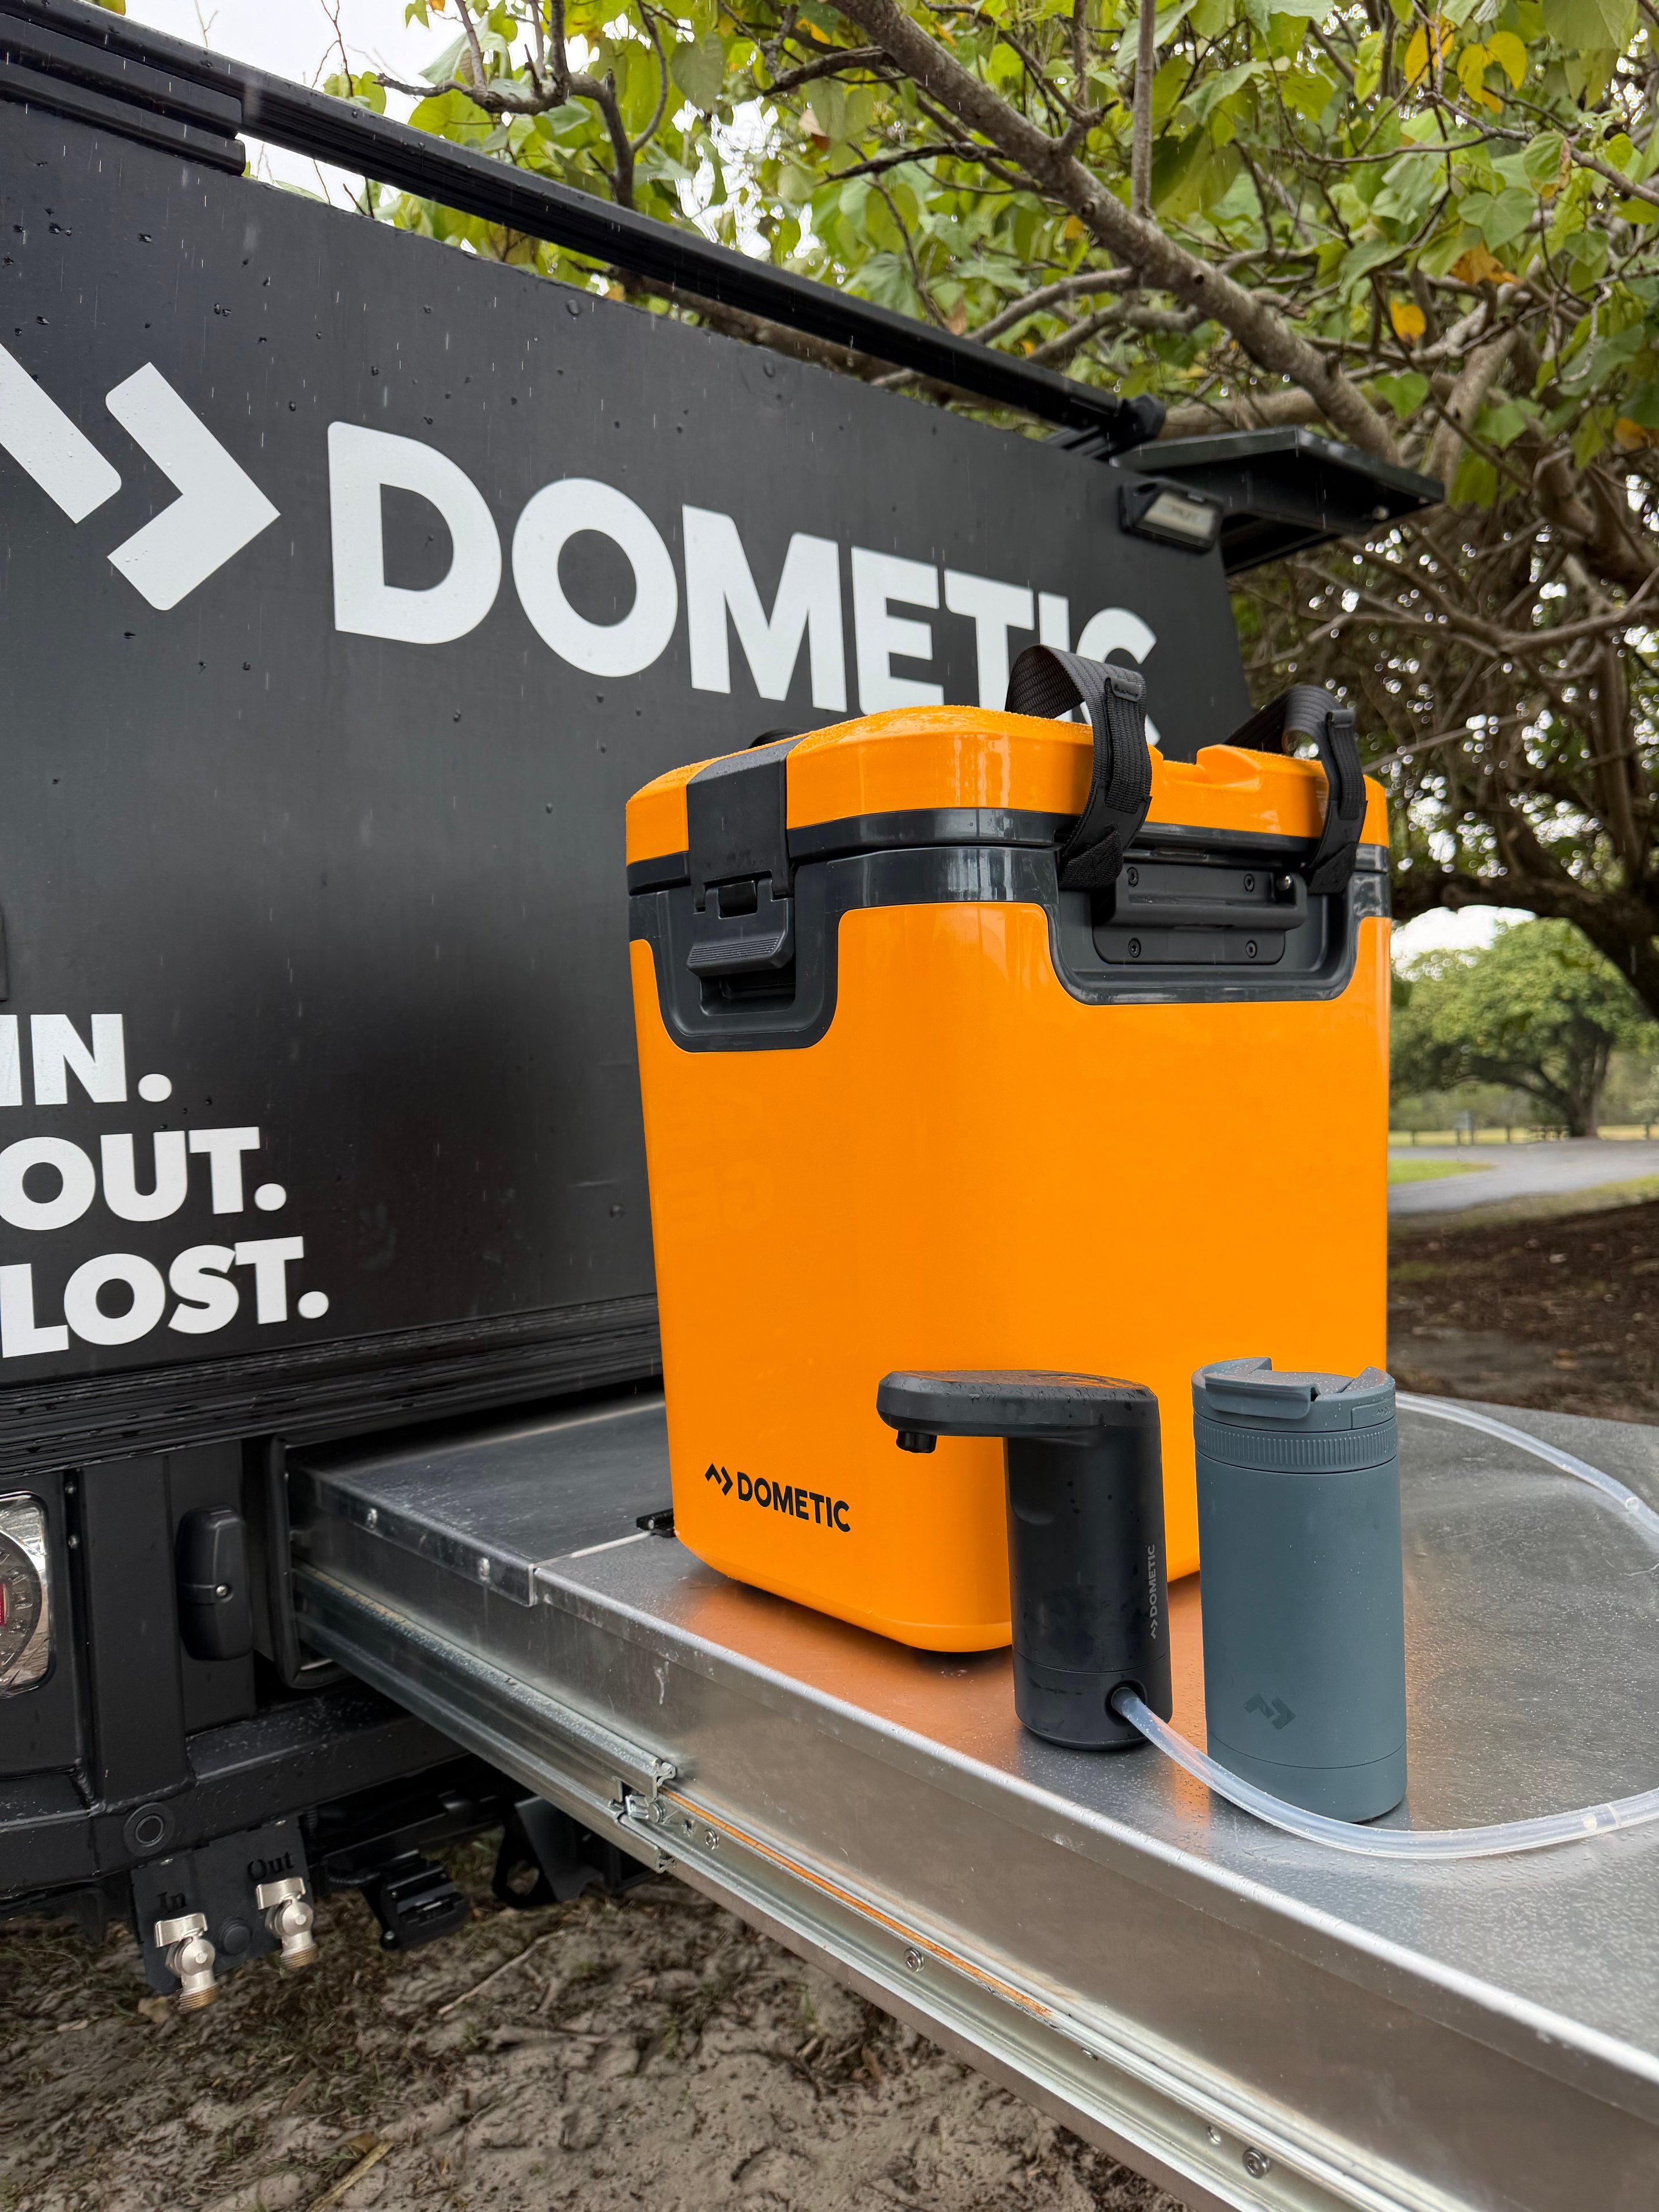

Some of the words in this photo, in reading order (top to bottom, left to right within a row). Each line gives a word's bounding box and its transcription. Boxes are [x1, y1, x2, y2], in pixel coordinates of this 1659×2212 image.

[0, 1126, 286, 1231] OUT.
[0, 1236, 329, 1358] LOST.
[737, 1471, 851, 1532] DOMETIC
[1147, 1544, 1158, 1618] DOMETIC
[247, 1851, 294, 1881] Out
[157, 1891, 188, 1912] In
